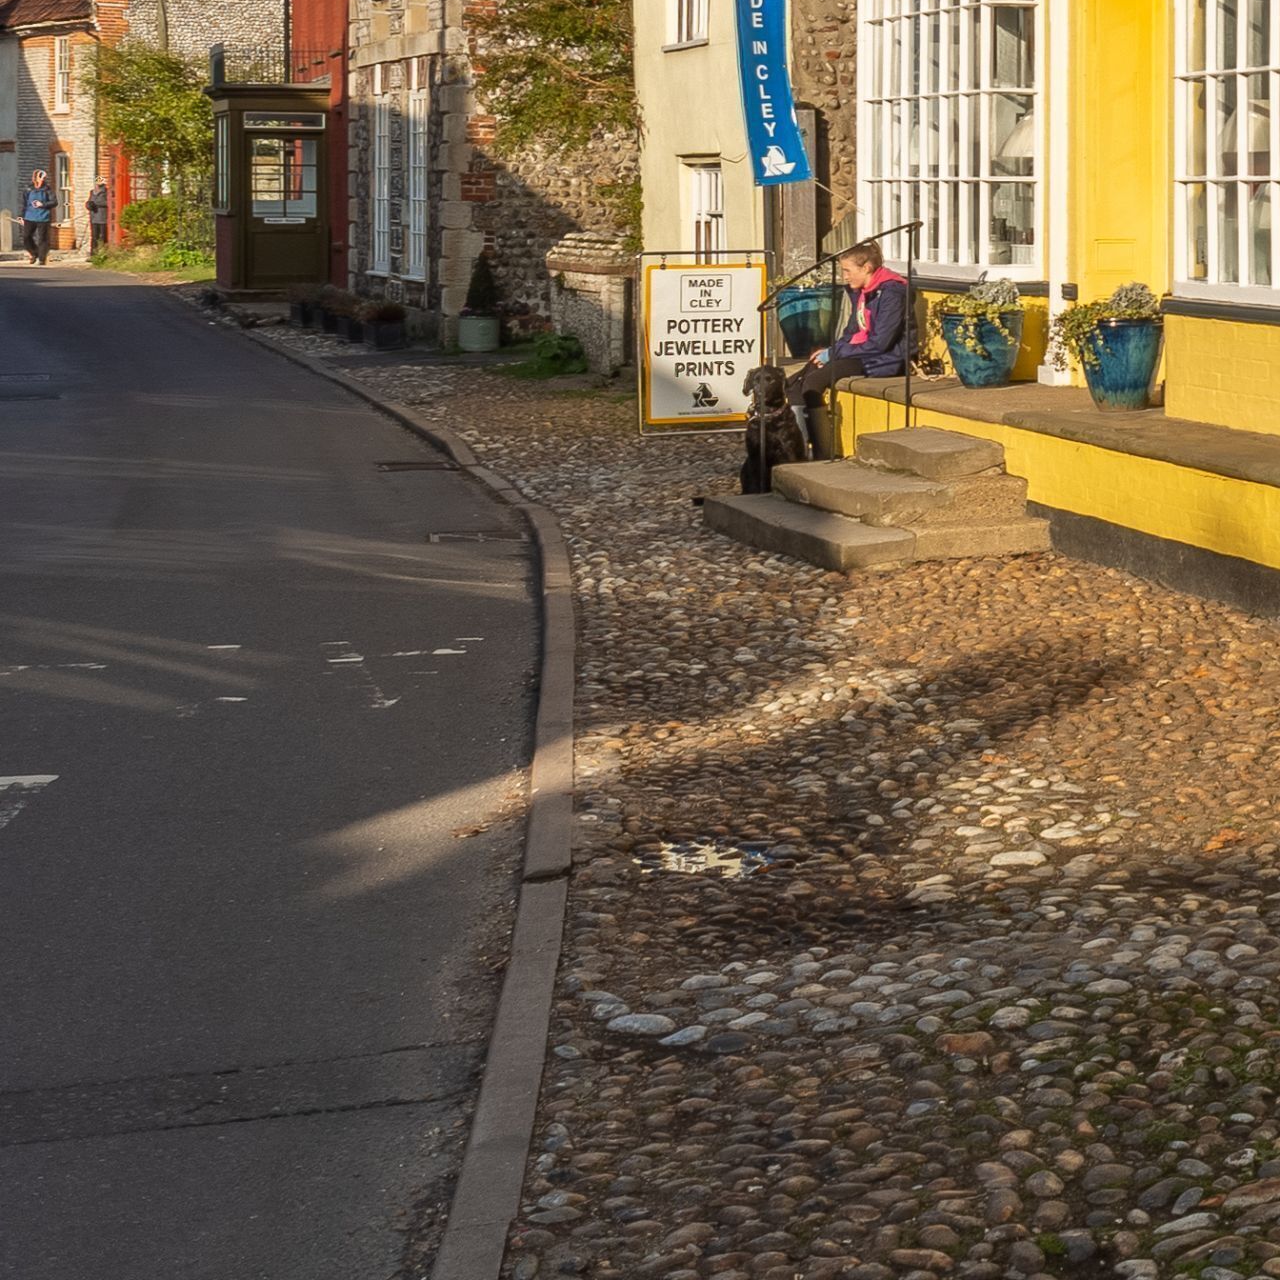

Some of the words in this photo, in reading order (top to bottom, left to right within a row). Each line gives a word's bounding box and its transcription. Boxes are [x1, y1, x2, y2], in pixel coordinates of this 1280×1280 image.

[752, 41, 768, 55] IN
[756, 64, 777, 138] CLEY
[688, 279, 724, 288] MADE
[700, 289, 712, 297] IN
[690, 299, 722, 308] CLEY
[667, 318, 744, 334] POTTERY
[654, 339, 755, 357] JEWELLERY
[674, 361, 735, 377] PRINTS
